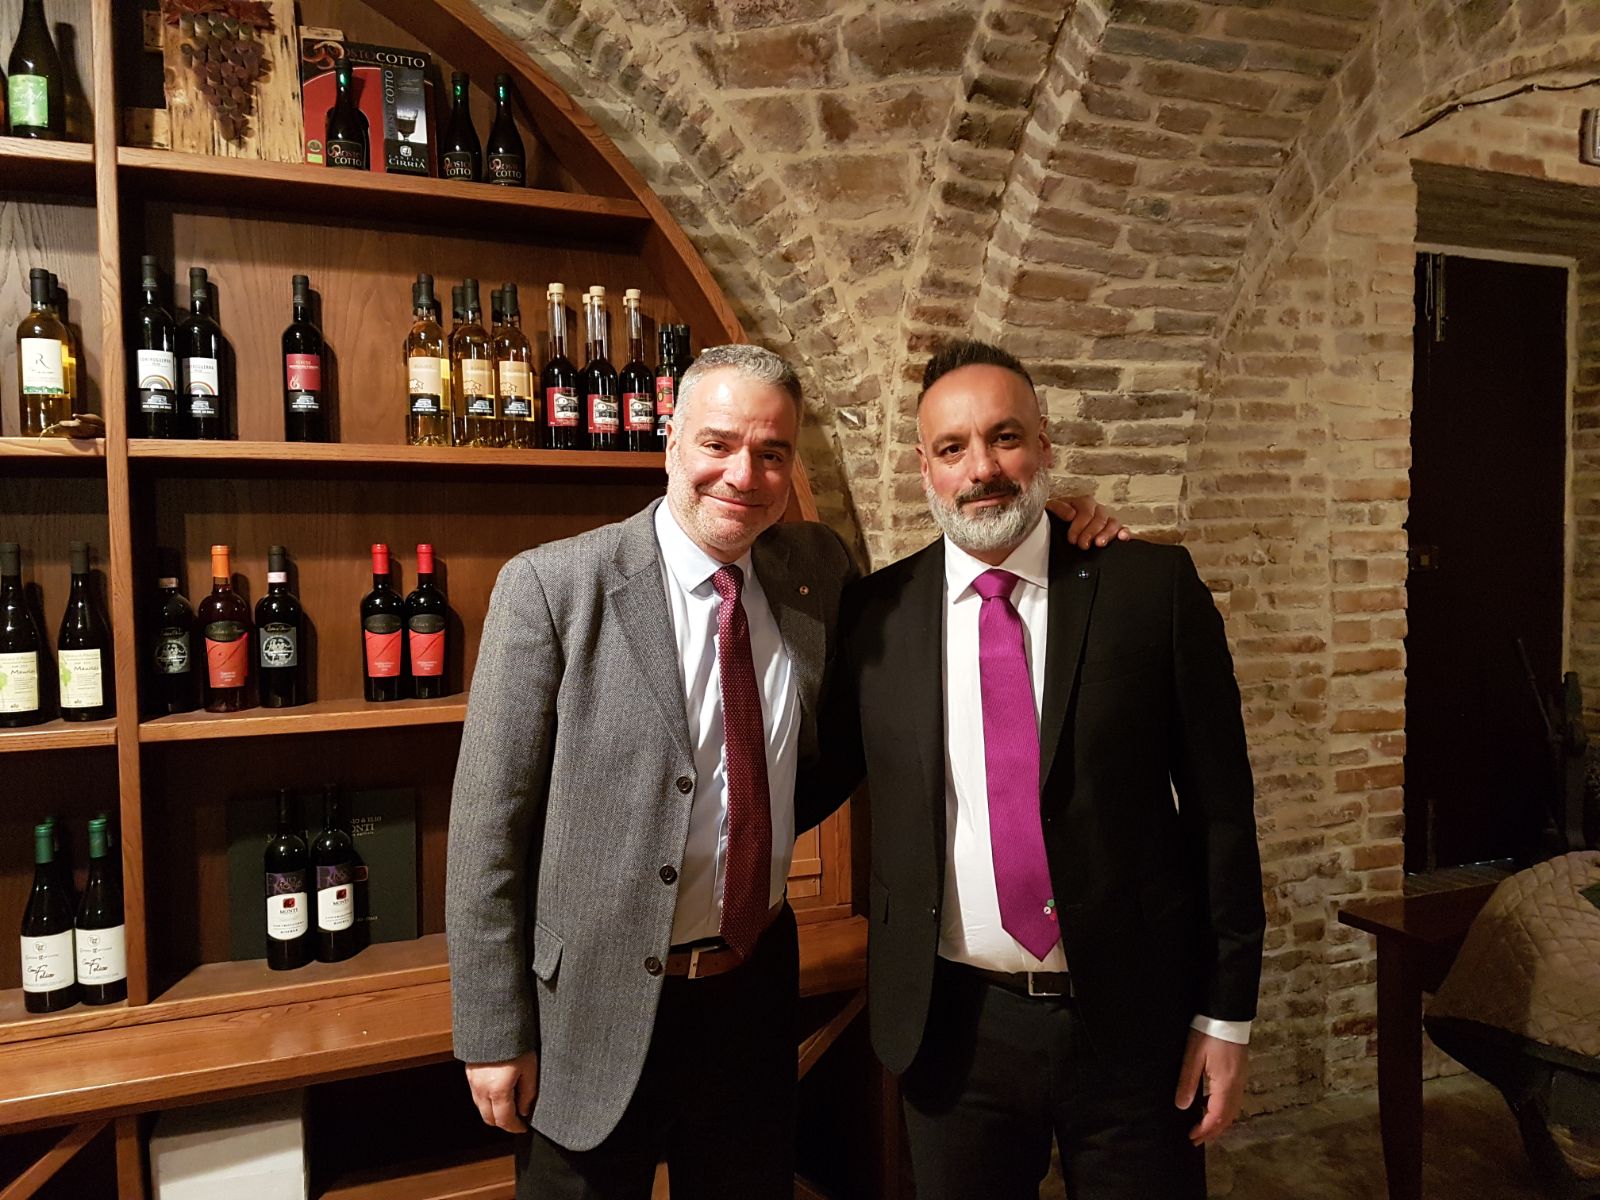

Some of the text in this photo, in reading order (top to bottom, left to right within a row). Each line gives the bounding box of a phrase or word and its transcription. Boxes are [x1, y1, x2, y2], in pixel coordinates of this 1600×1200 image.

[376, 52, 425, 68] COTTO
[385, 70, 395, 104] COTTO
[335, 156, 362, 167] COTTO
[446, 167, 471, 176] COTTO
[496, 170, 522, 179] COTTO
[351, 823, 376, 834] ONTI
